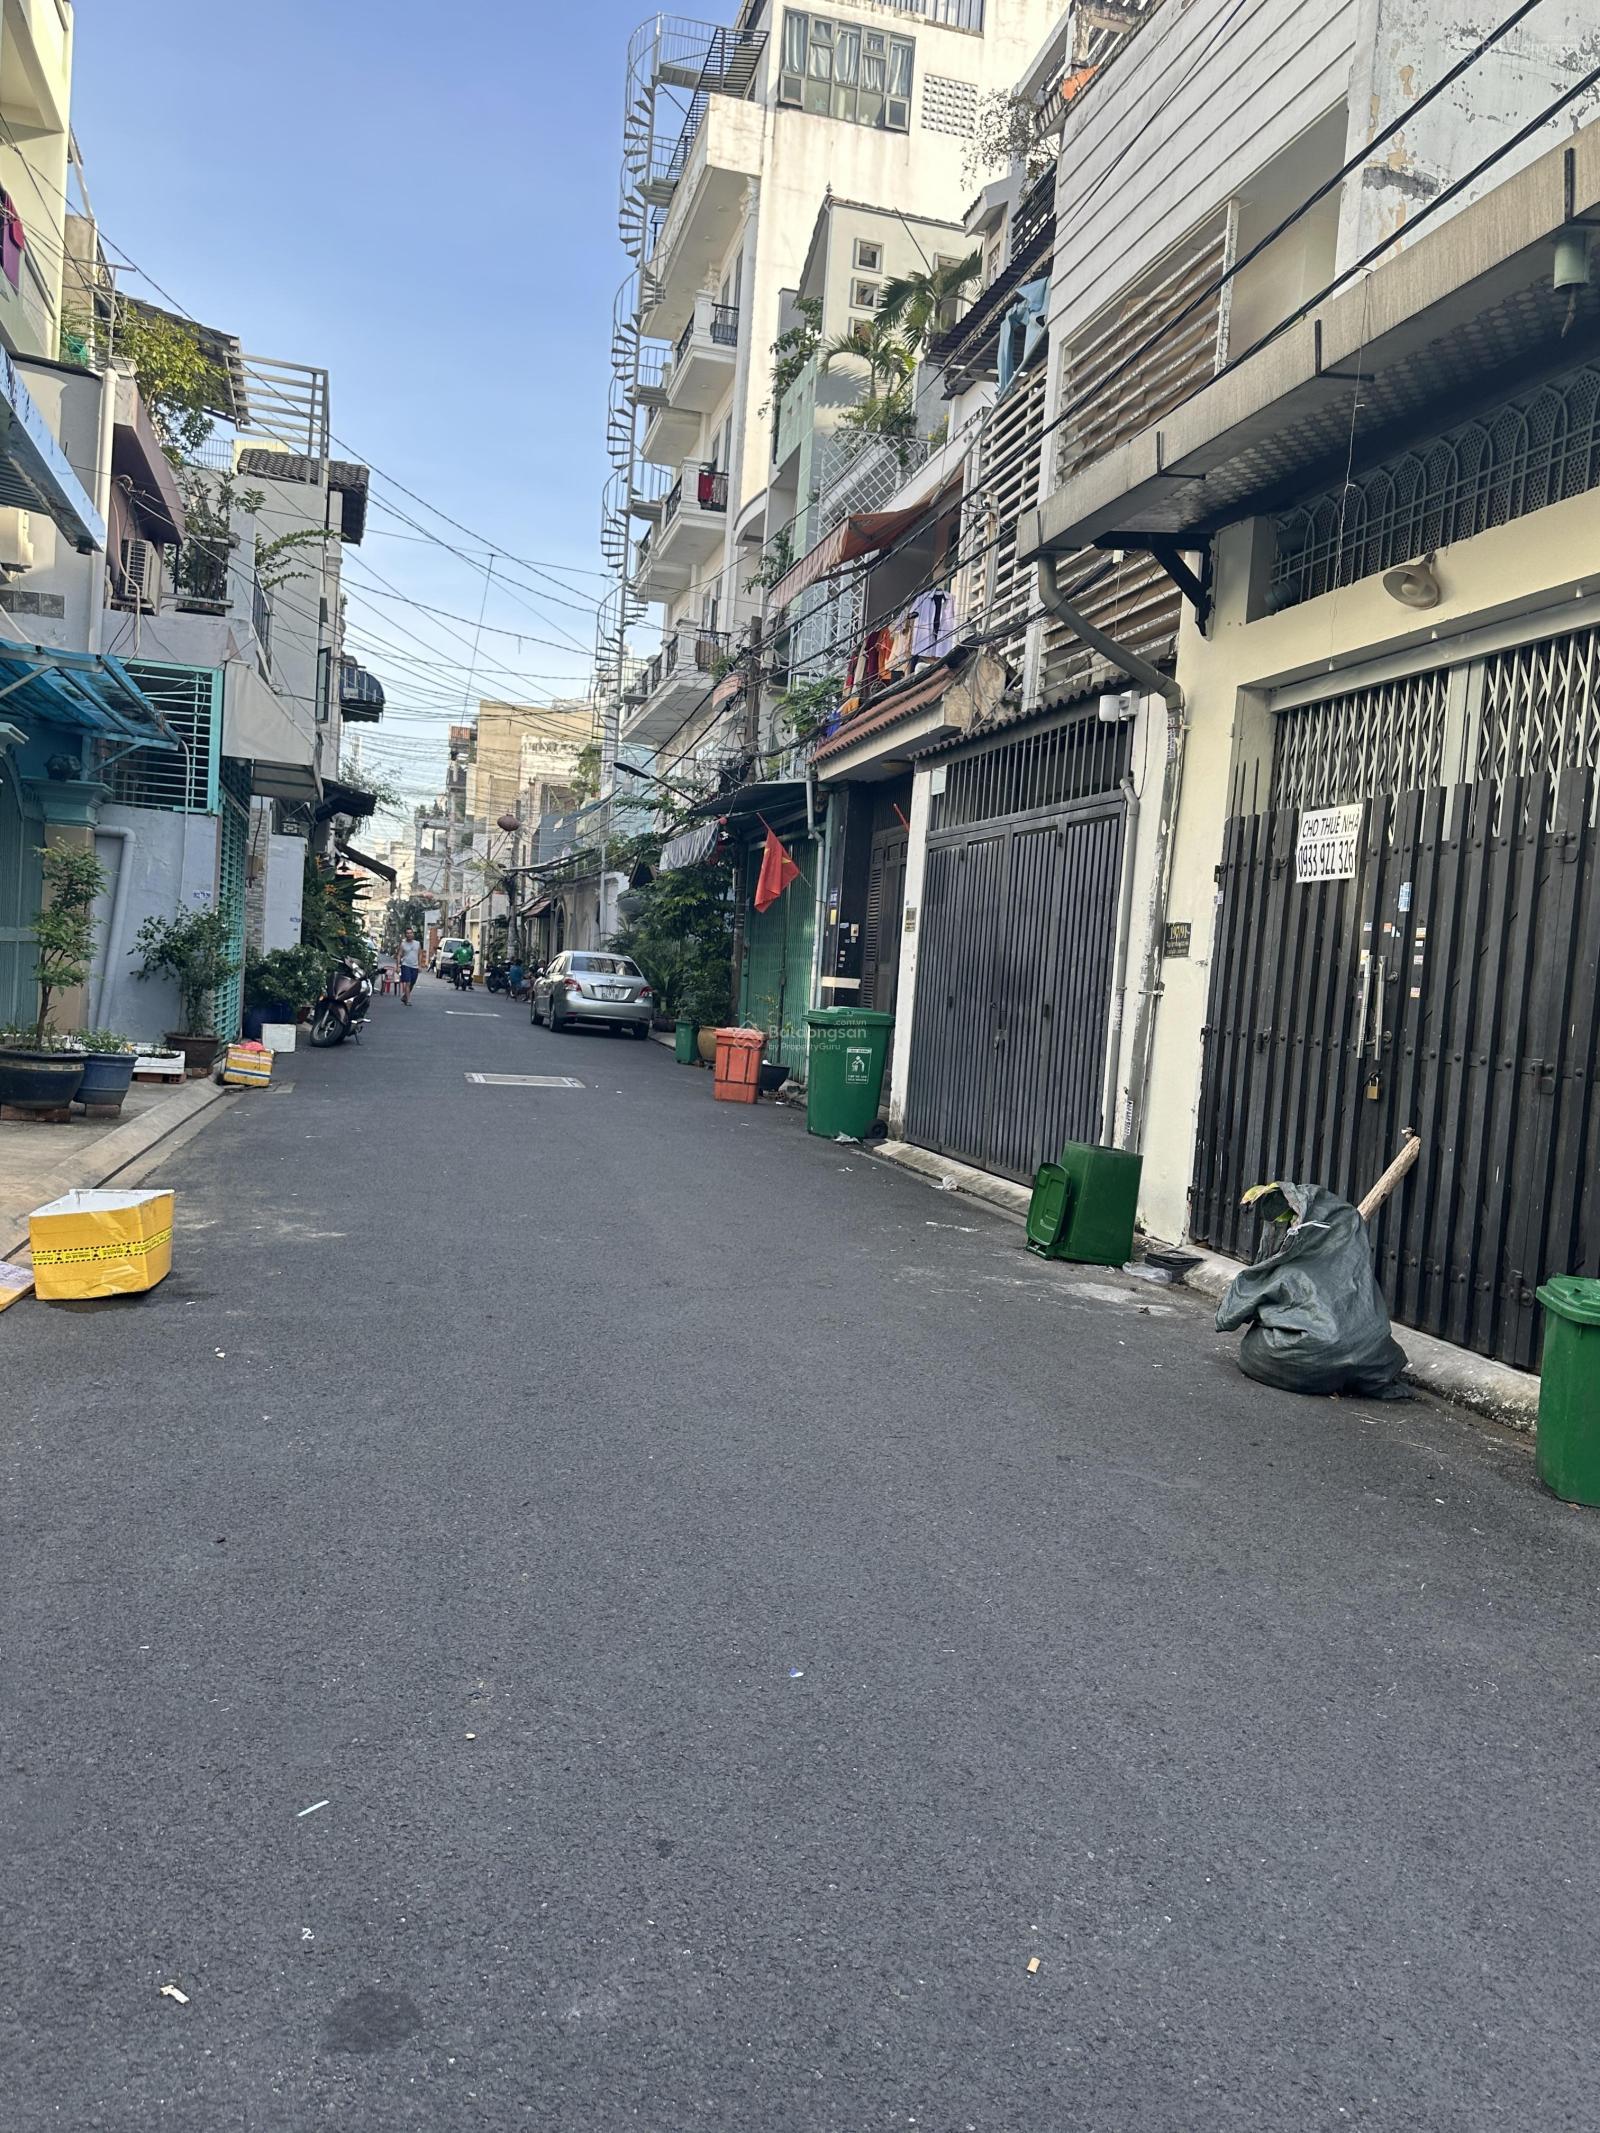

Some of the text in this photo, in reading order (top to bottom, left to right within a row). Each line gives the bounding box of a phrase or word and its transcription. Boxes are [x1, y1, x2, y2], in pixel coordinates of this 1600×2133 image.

[1302, 807, 1360, 838] CHO THUÊ NHÀ
[1298, 839, 1355, 877] 0933 922 326
